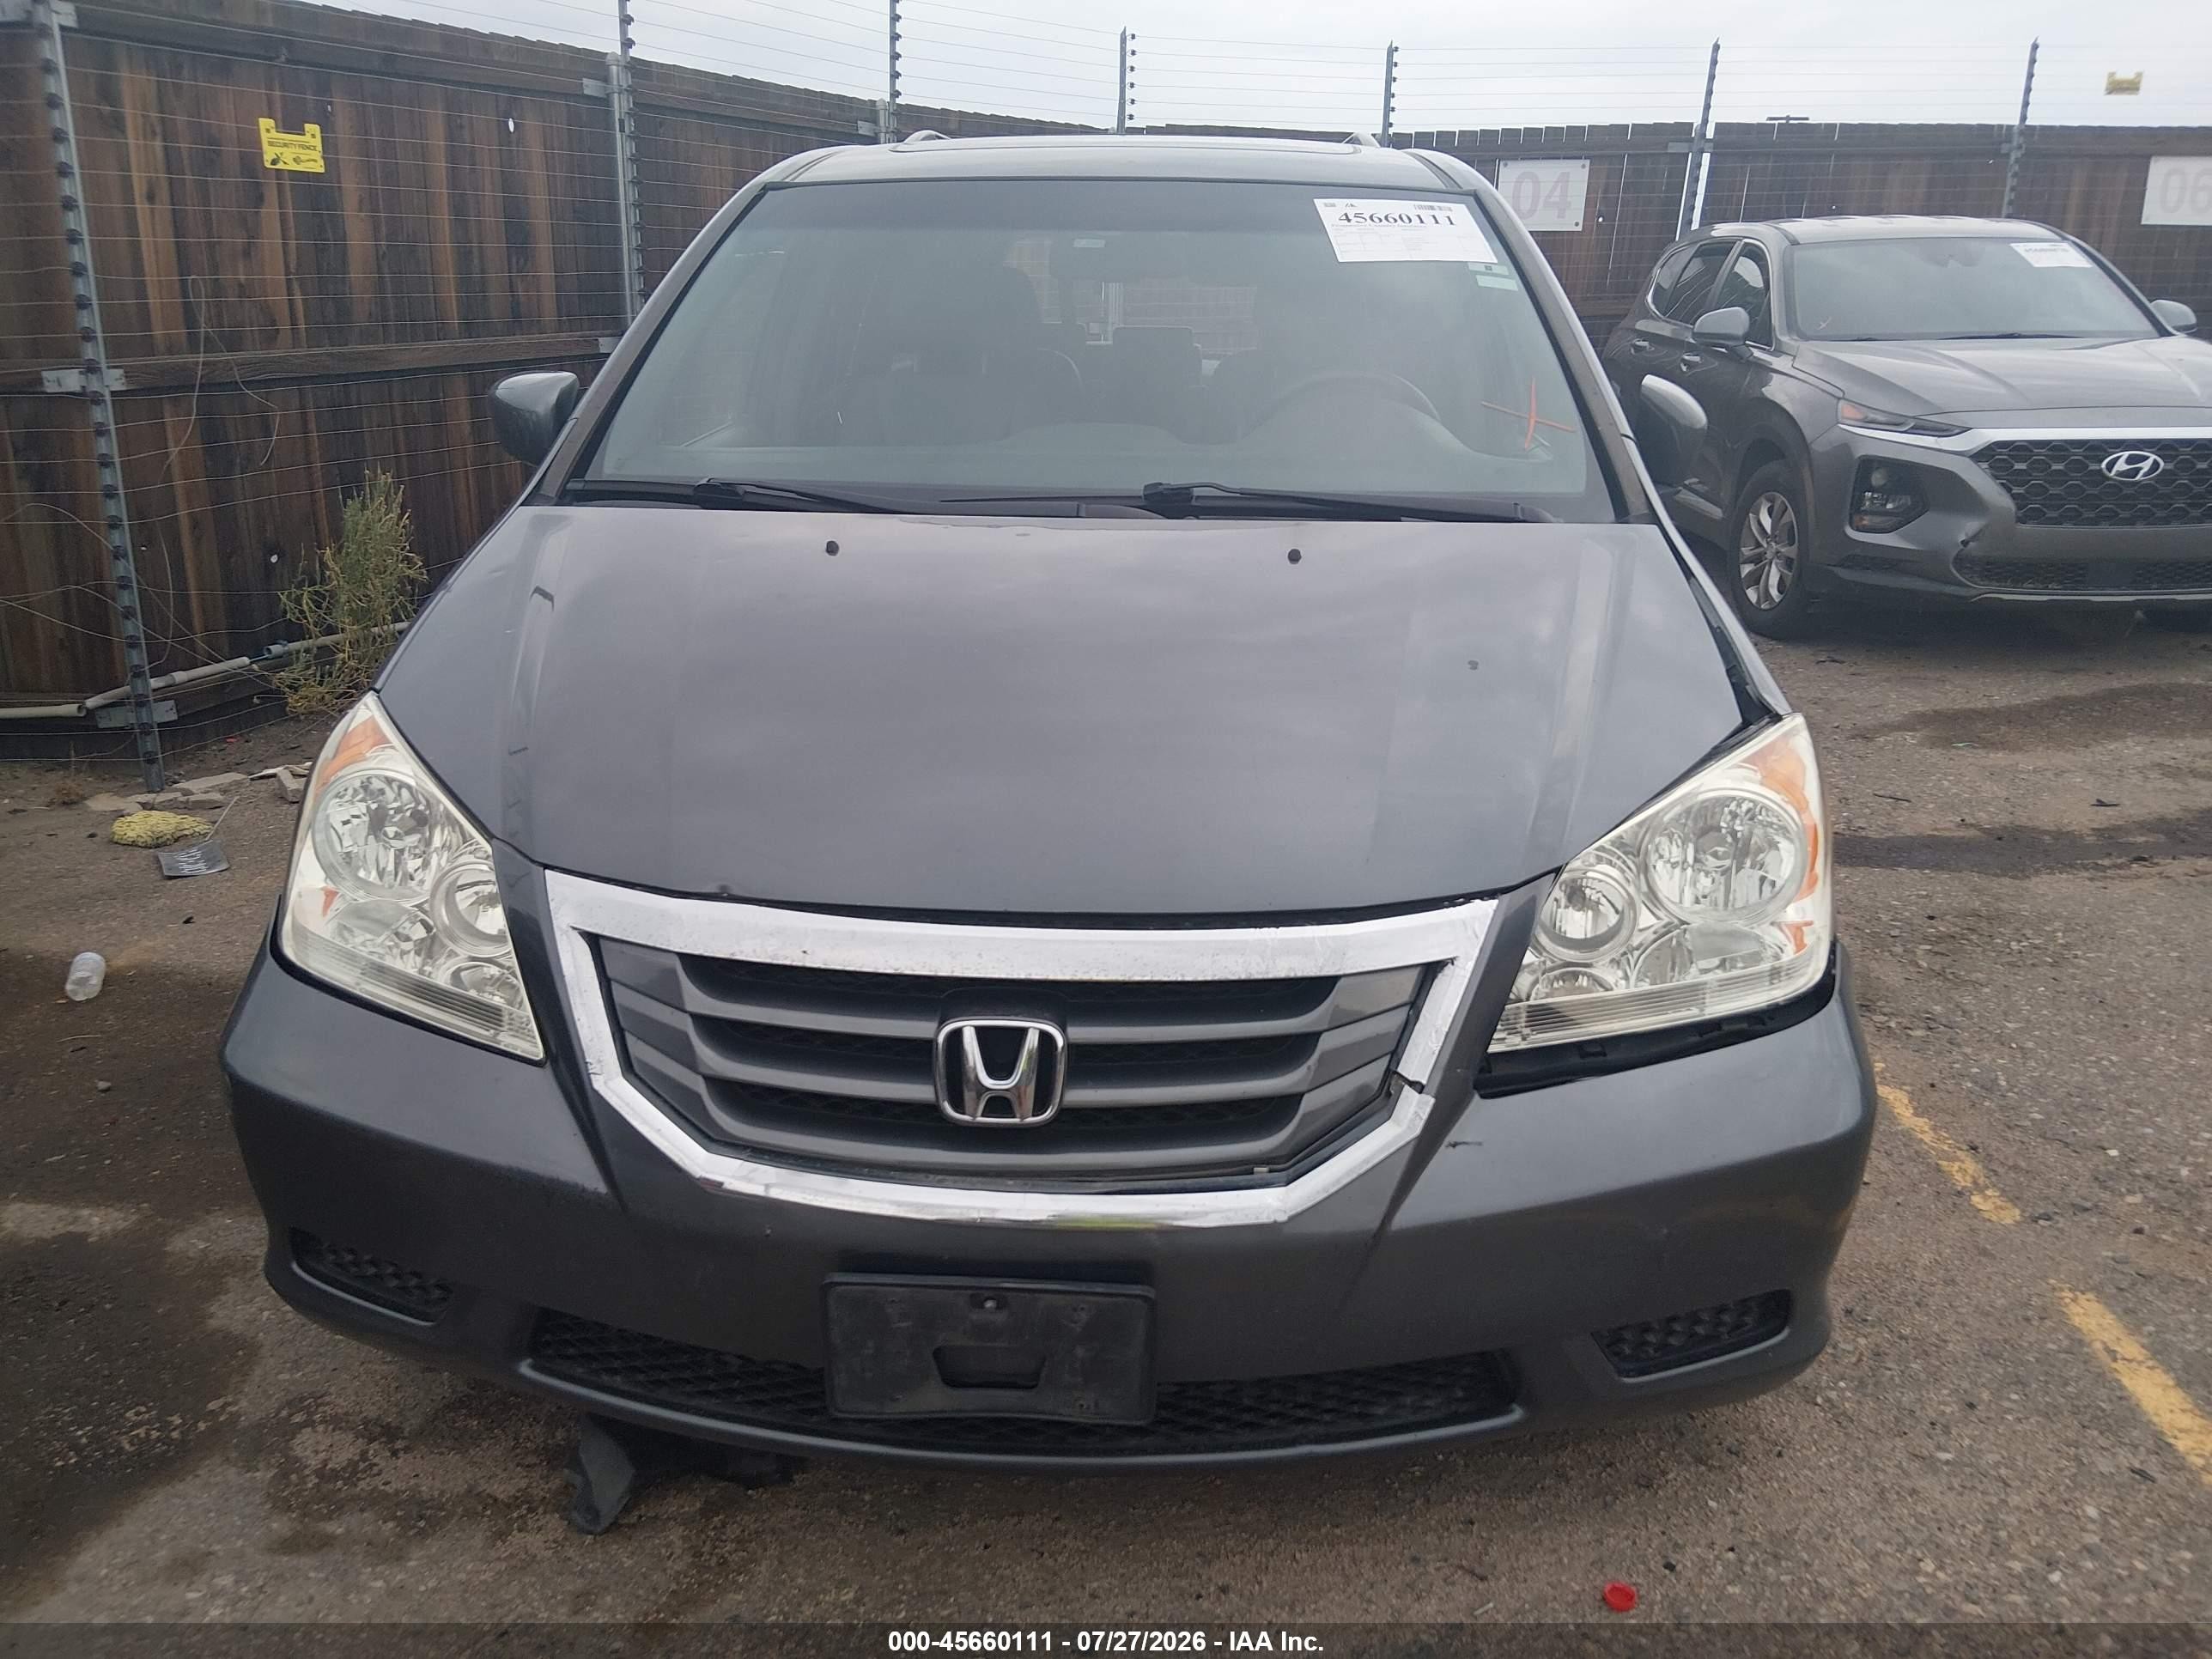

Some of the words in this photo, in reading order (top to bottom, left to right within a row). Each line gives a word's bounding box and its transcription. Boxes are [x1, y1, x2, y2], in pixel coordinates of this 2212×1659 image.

[267, 141, 297, 149] SECURITY
[1511, 172, 1571, 220] 04
[2160, 167, 2212, 214] 06
[1339, 212, 1455, 226] 45660111
